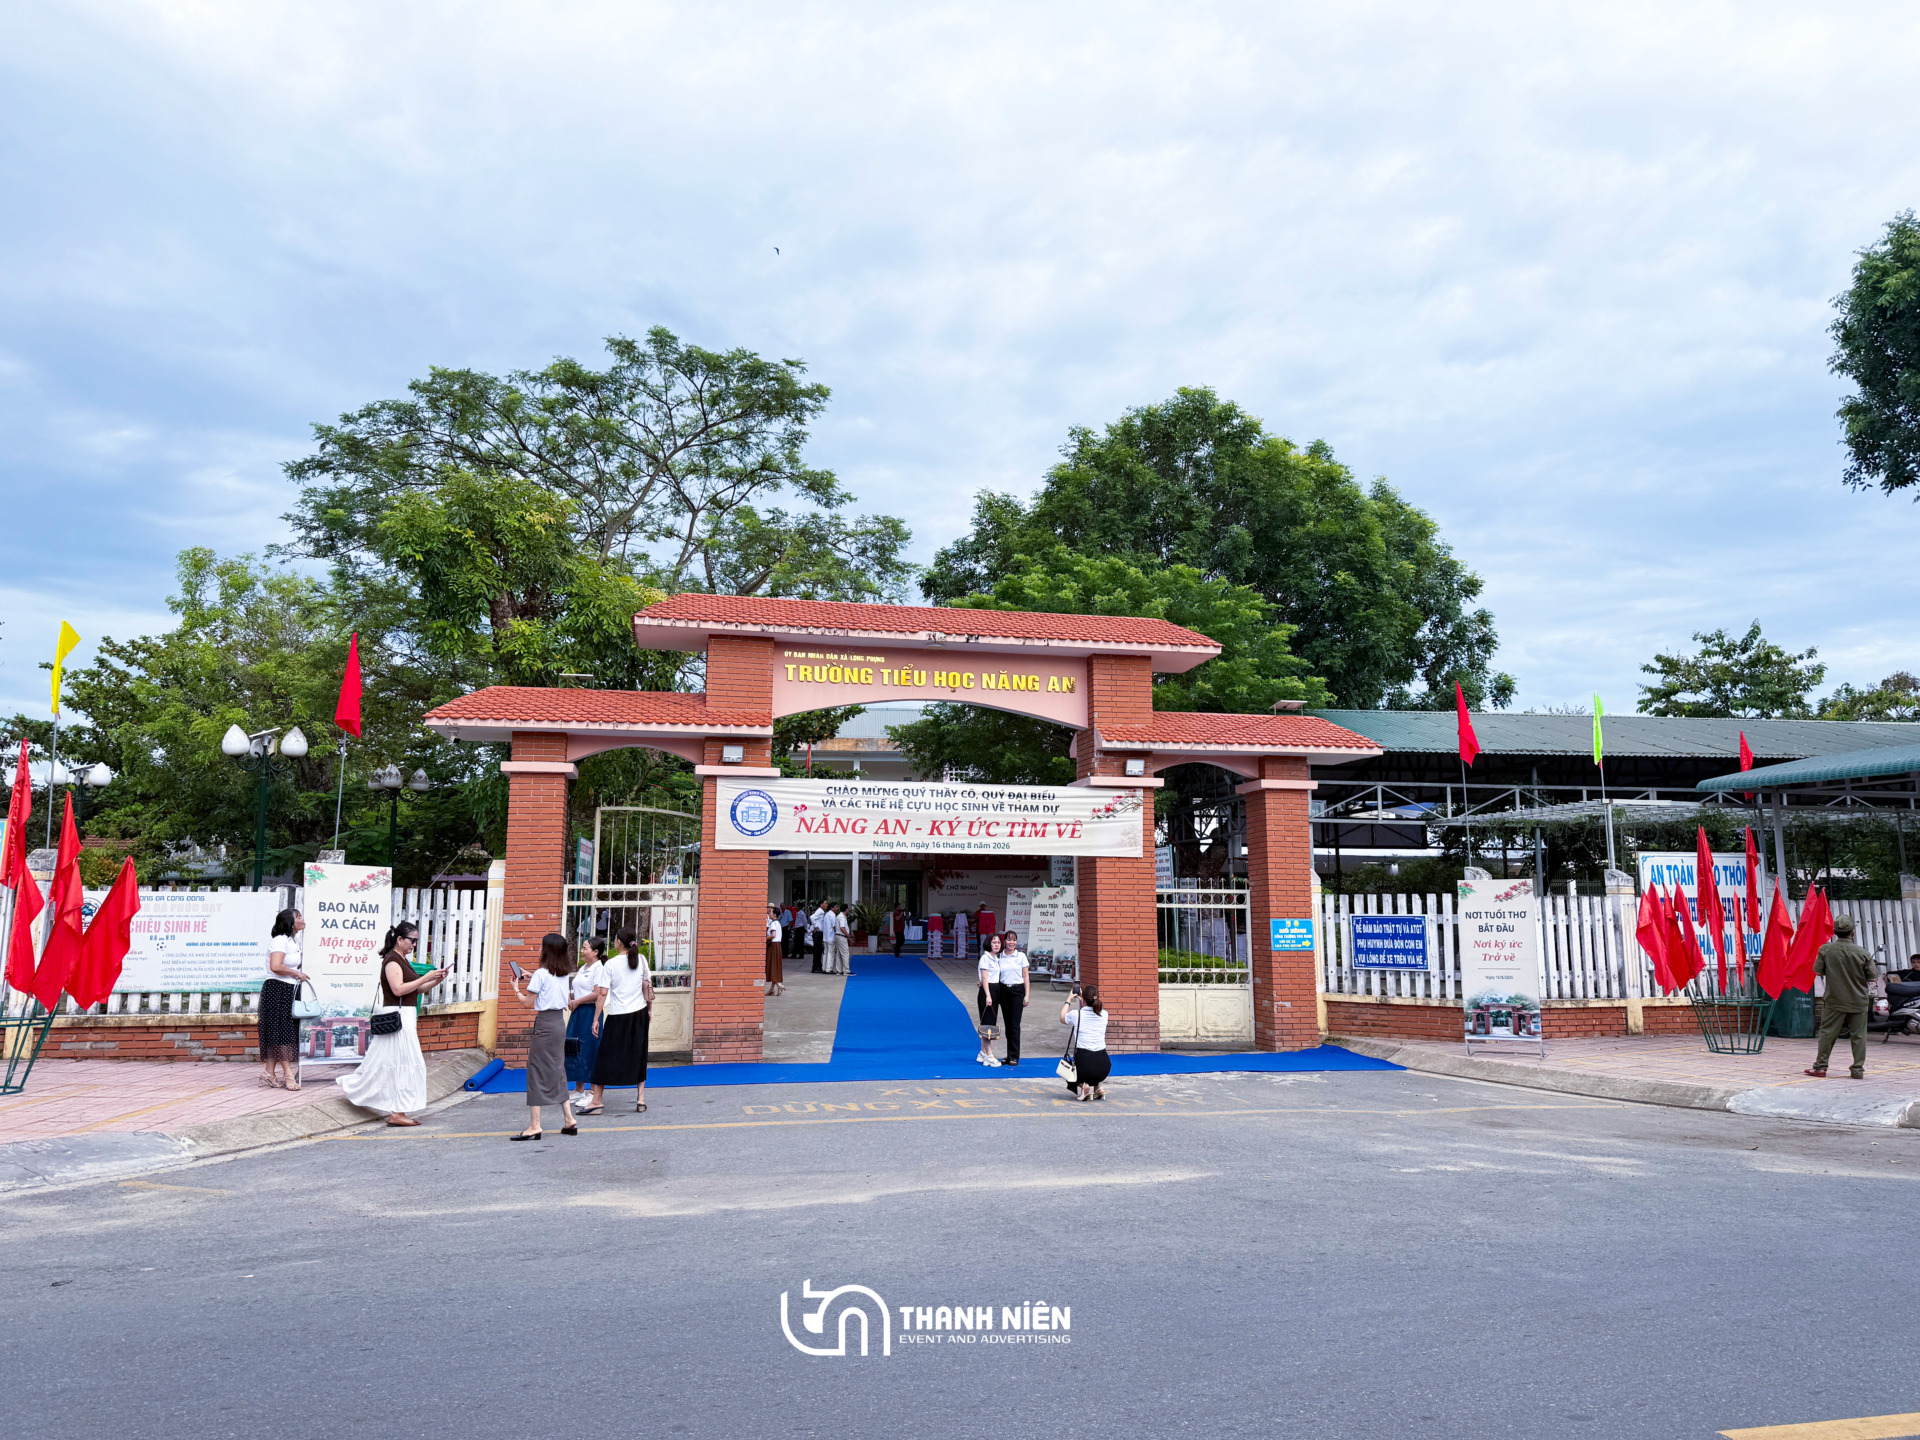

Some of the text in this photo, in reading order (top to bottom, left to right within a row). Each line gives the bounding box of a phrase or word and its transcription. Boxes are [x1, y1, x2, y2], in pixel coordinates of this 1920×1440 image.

[866, 656, 885, 664] PHỤNG
[784, 661, 1076, 693] TRƯỜNG TIỂU HỌC NĂNG AN
[826, 784, 1056, 802] CHÀO MỪNG QUÝ THẦY CÔ, QUÝ ĐẠI BIỂU
[821, 797, 1060, 815] VÀ CÁC THẾ HỆ CỰU HỌC SINH VỀ THAM DỰ
[795, 813, 868, 834] NĂNG
[873, 819, 911, 835] AN
[928, 816, 962, 836] KÝ
[967, 817, 1000, 837] ỨC
[1006, 818, 1047, 838] TÌM
[1056, 818, 1083, 839] VỀ
[873, 840, 894, 849] Năng
[896, 840, 909, 849] An,
[911, 841, 930, 850] ngày
[942, 841, 965, 850] tháng
[992, 842, 1010, 850] 2026
[1651, 864, 1664, 885] AN
[1666, 859, 1694, 886] TOÀN
[1722, 861, 1747, 886] THÔN
[318, 901, 379, 914] BAO NĂM
[1465, 908, 1527, 919] NƠI TUỔI THƠ
[164, 920, 191, 933] SINH
[193, 918, 208, 933] HÈ
[320, 916, 376, 930] XA CÁCH
[1355, 918, 1362, 934] ĐỂ
[1373, 920, 1383, 934] BẢO
[1383, 921, 1395, 937] TRẬT
[1396, 922, 1402, 937] TỰ
[1403, 922, 1410, 934] VÀ
[1410, 924, 1422, 934] ATGT
[1478, 922, 1515, 933] BẮT ĐẦU
[319, 936, 377, 950] Một ngày
[1356, 939, 1366, 951] PHỤ
[1367, 939, 1383, 949] HUYNH
[1405, 940, 1415, 949] CON
[1416, 940, 1423, 950] EM
[1473, 940, 1523, 951] Nơi ký ức
[328, 952, 368, 964] Trở về
[1357, 954, 1366, 964] VUI
[1366, 951, 1379, 964] LÒNG
[1379, 949, 1386, 964] ĐỂ
[1387, 954, 1394, 964] XE
[1394, 953, 1407, 964] TRÊN
[1416, 952, 1423, 965] HÈ
[1482, 952, 1516, 962] Trở về
[875, 1088, 970, 1096] XIN
[908, 1099, 999, 1110] XE
